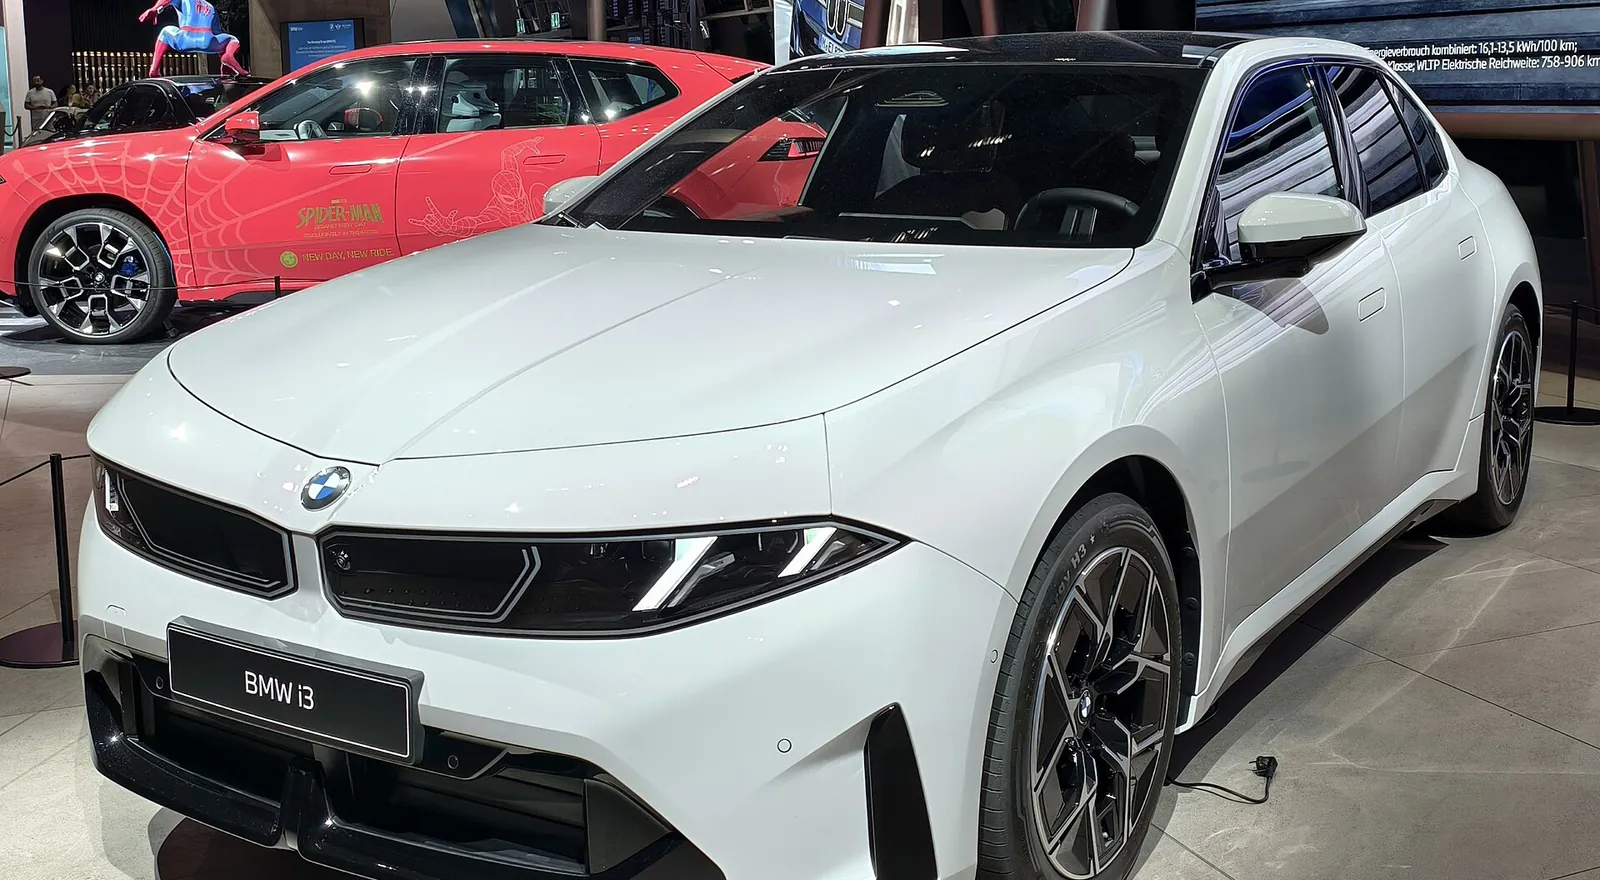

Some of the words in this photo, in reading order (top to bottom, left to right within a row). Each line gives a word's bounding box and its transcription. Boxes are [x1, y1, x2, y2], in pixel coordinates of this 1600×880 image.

[1431, 43, 1478, 56] kombiniert:
[1478, 41, 1515, 55] 16,1-13,5
[1516, 39, 1558, 53] kWh/100
[1560, 39, 1578, 53] km;
[1416, 59, 1440, 71] WLTP
[1442, 57, 1488, 71] Elektrische
[1489, 56, 1540, 69] Reichweite:
[1541, 54, 1585, 68] 758-906
[296, 203, 385, 229] SPIDER-MAN
[302, 252, 324, 262] NEW
[325, 250, 346, 261] DAY,
[347, 249, 368, 259] NEW
[244, 670, 293, 704] BMW
[298, 684, 315, 710] i3
